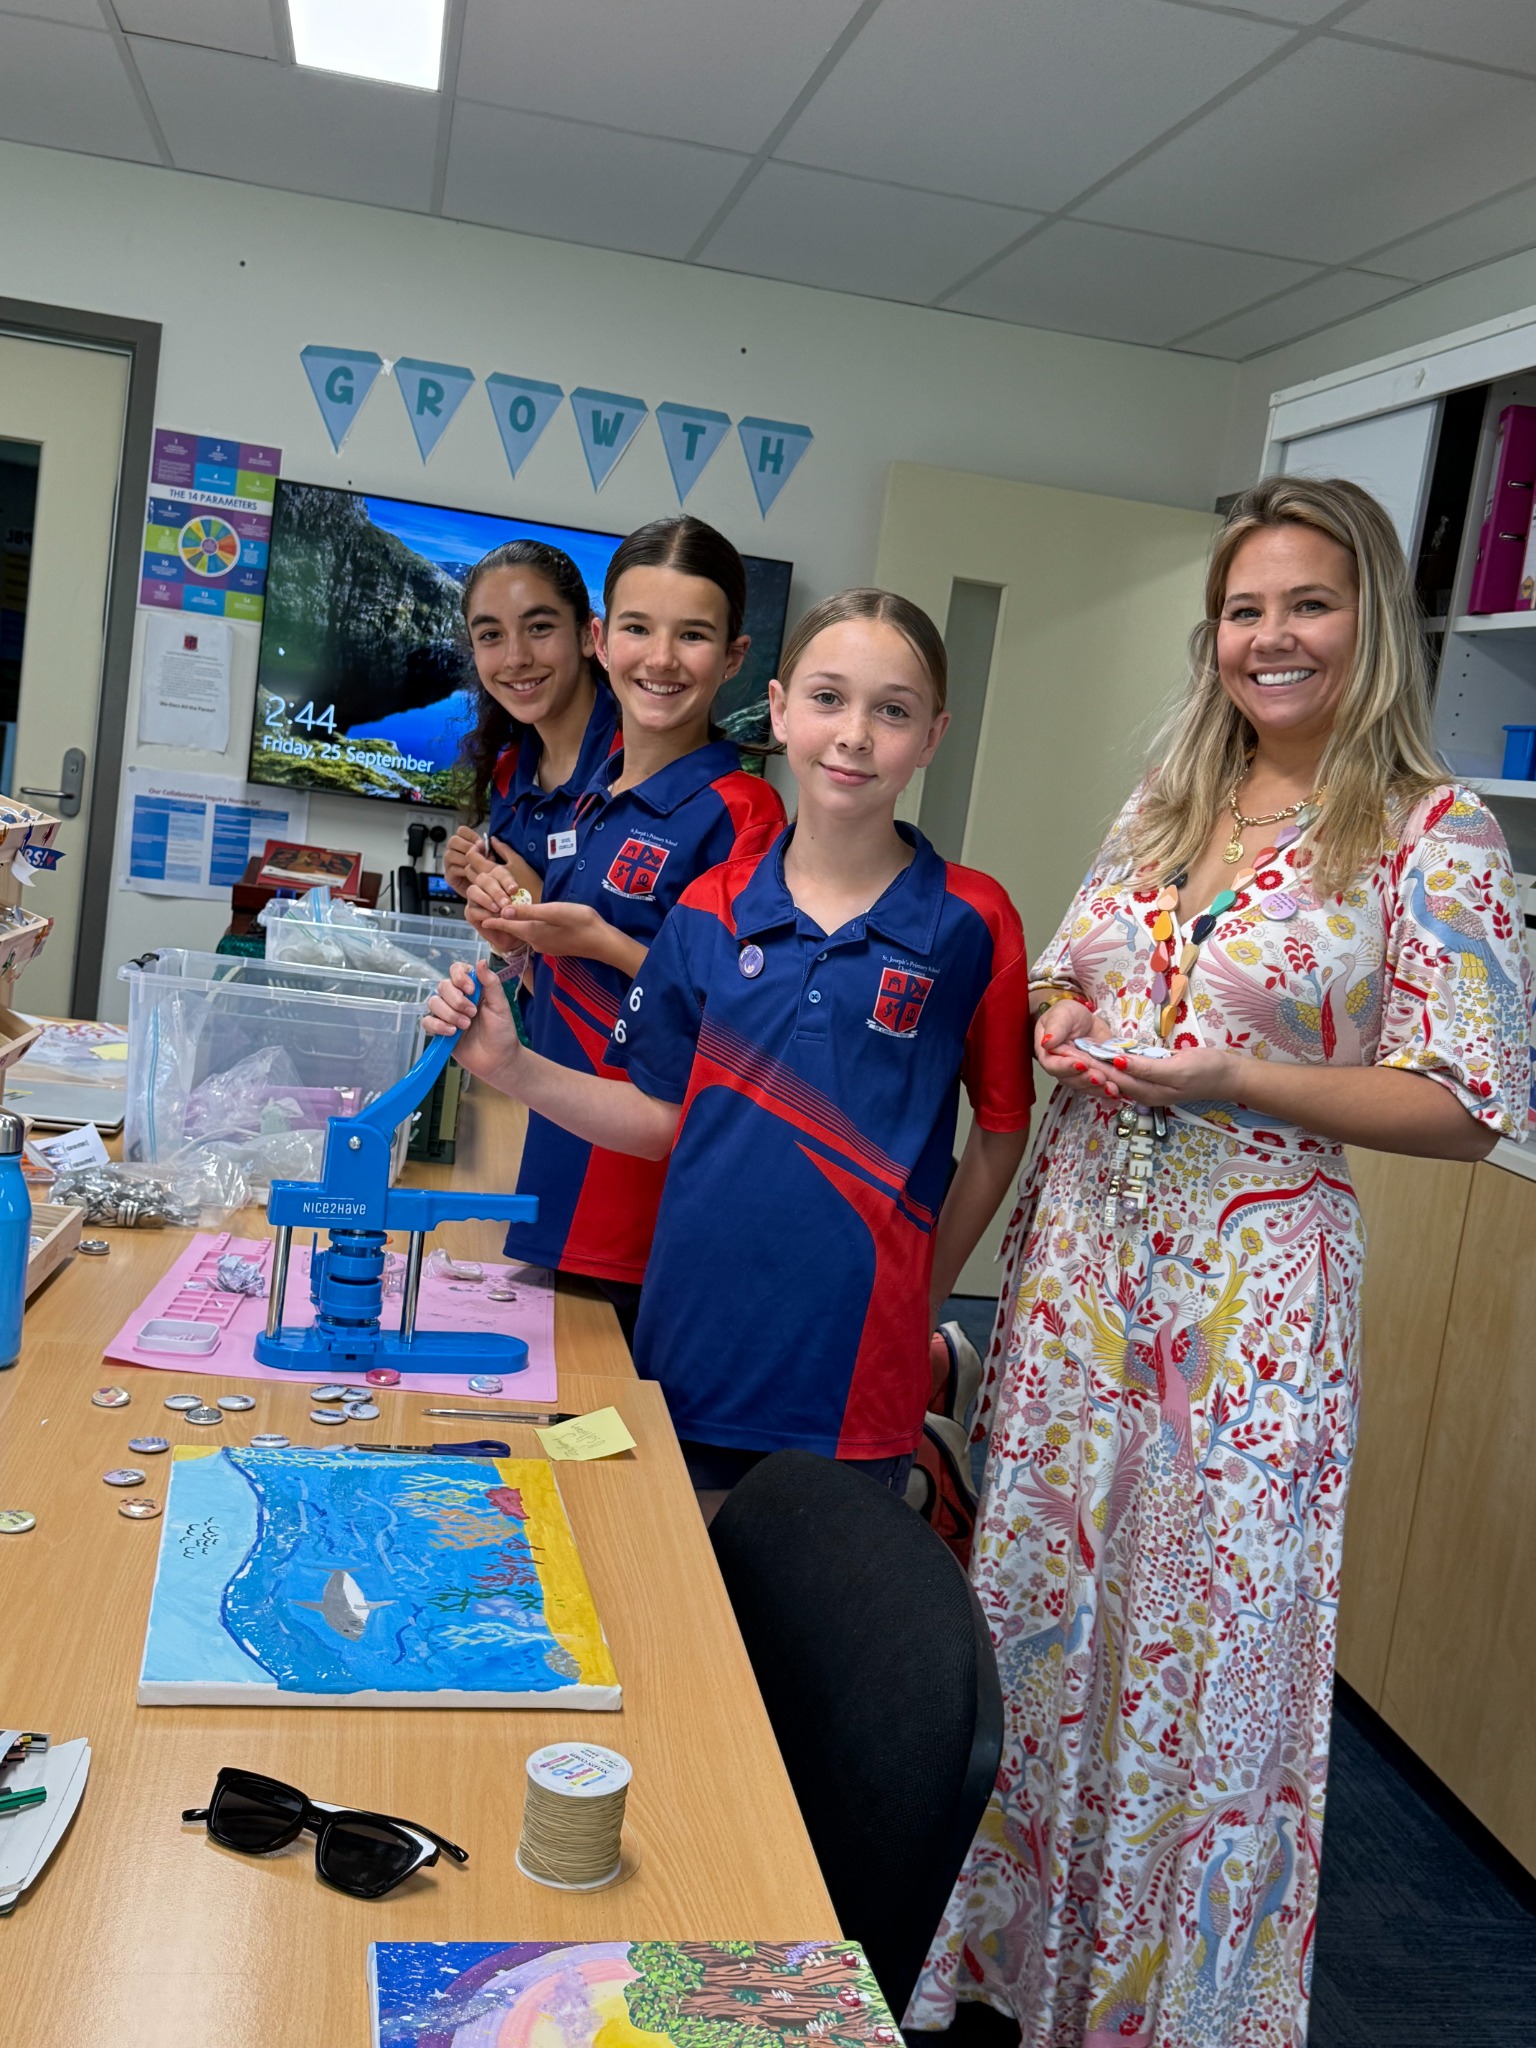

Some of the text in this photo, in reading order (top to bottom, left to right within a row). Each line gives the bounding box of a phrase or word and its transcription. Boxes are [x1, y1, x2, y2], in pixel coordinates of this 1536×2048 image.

[325, 366, 784, 475] GROWTH
[170, 489, 257, 511] THE 14 PARAMETERS
[264, 696, 337, 734] 2:44
[262, 735, 435, 773] Friday, 25 September
[148, 787, 161, 795] Our
[162, 789, 204, 800] Collaborative
[205, 794, 227, 803] Inquiry
[629, 986, 643, 1012] 6
